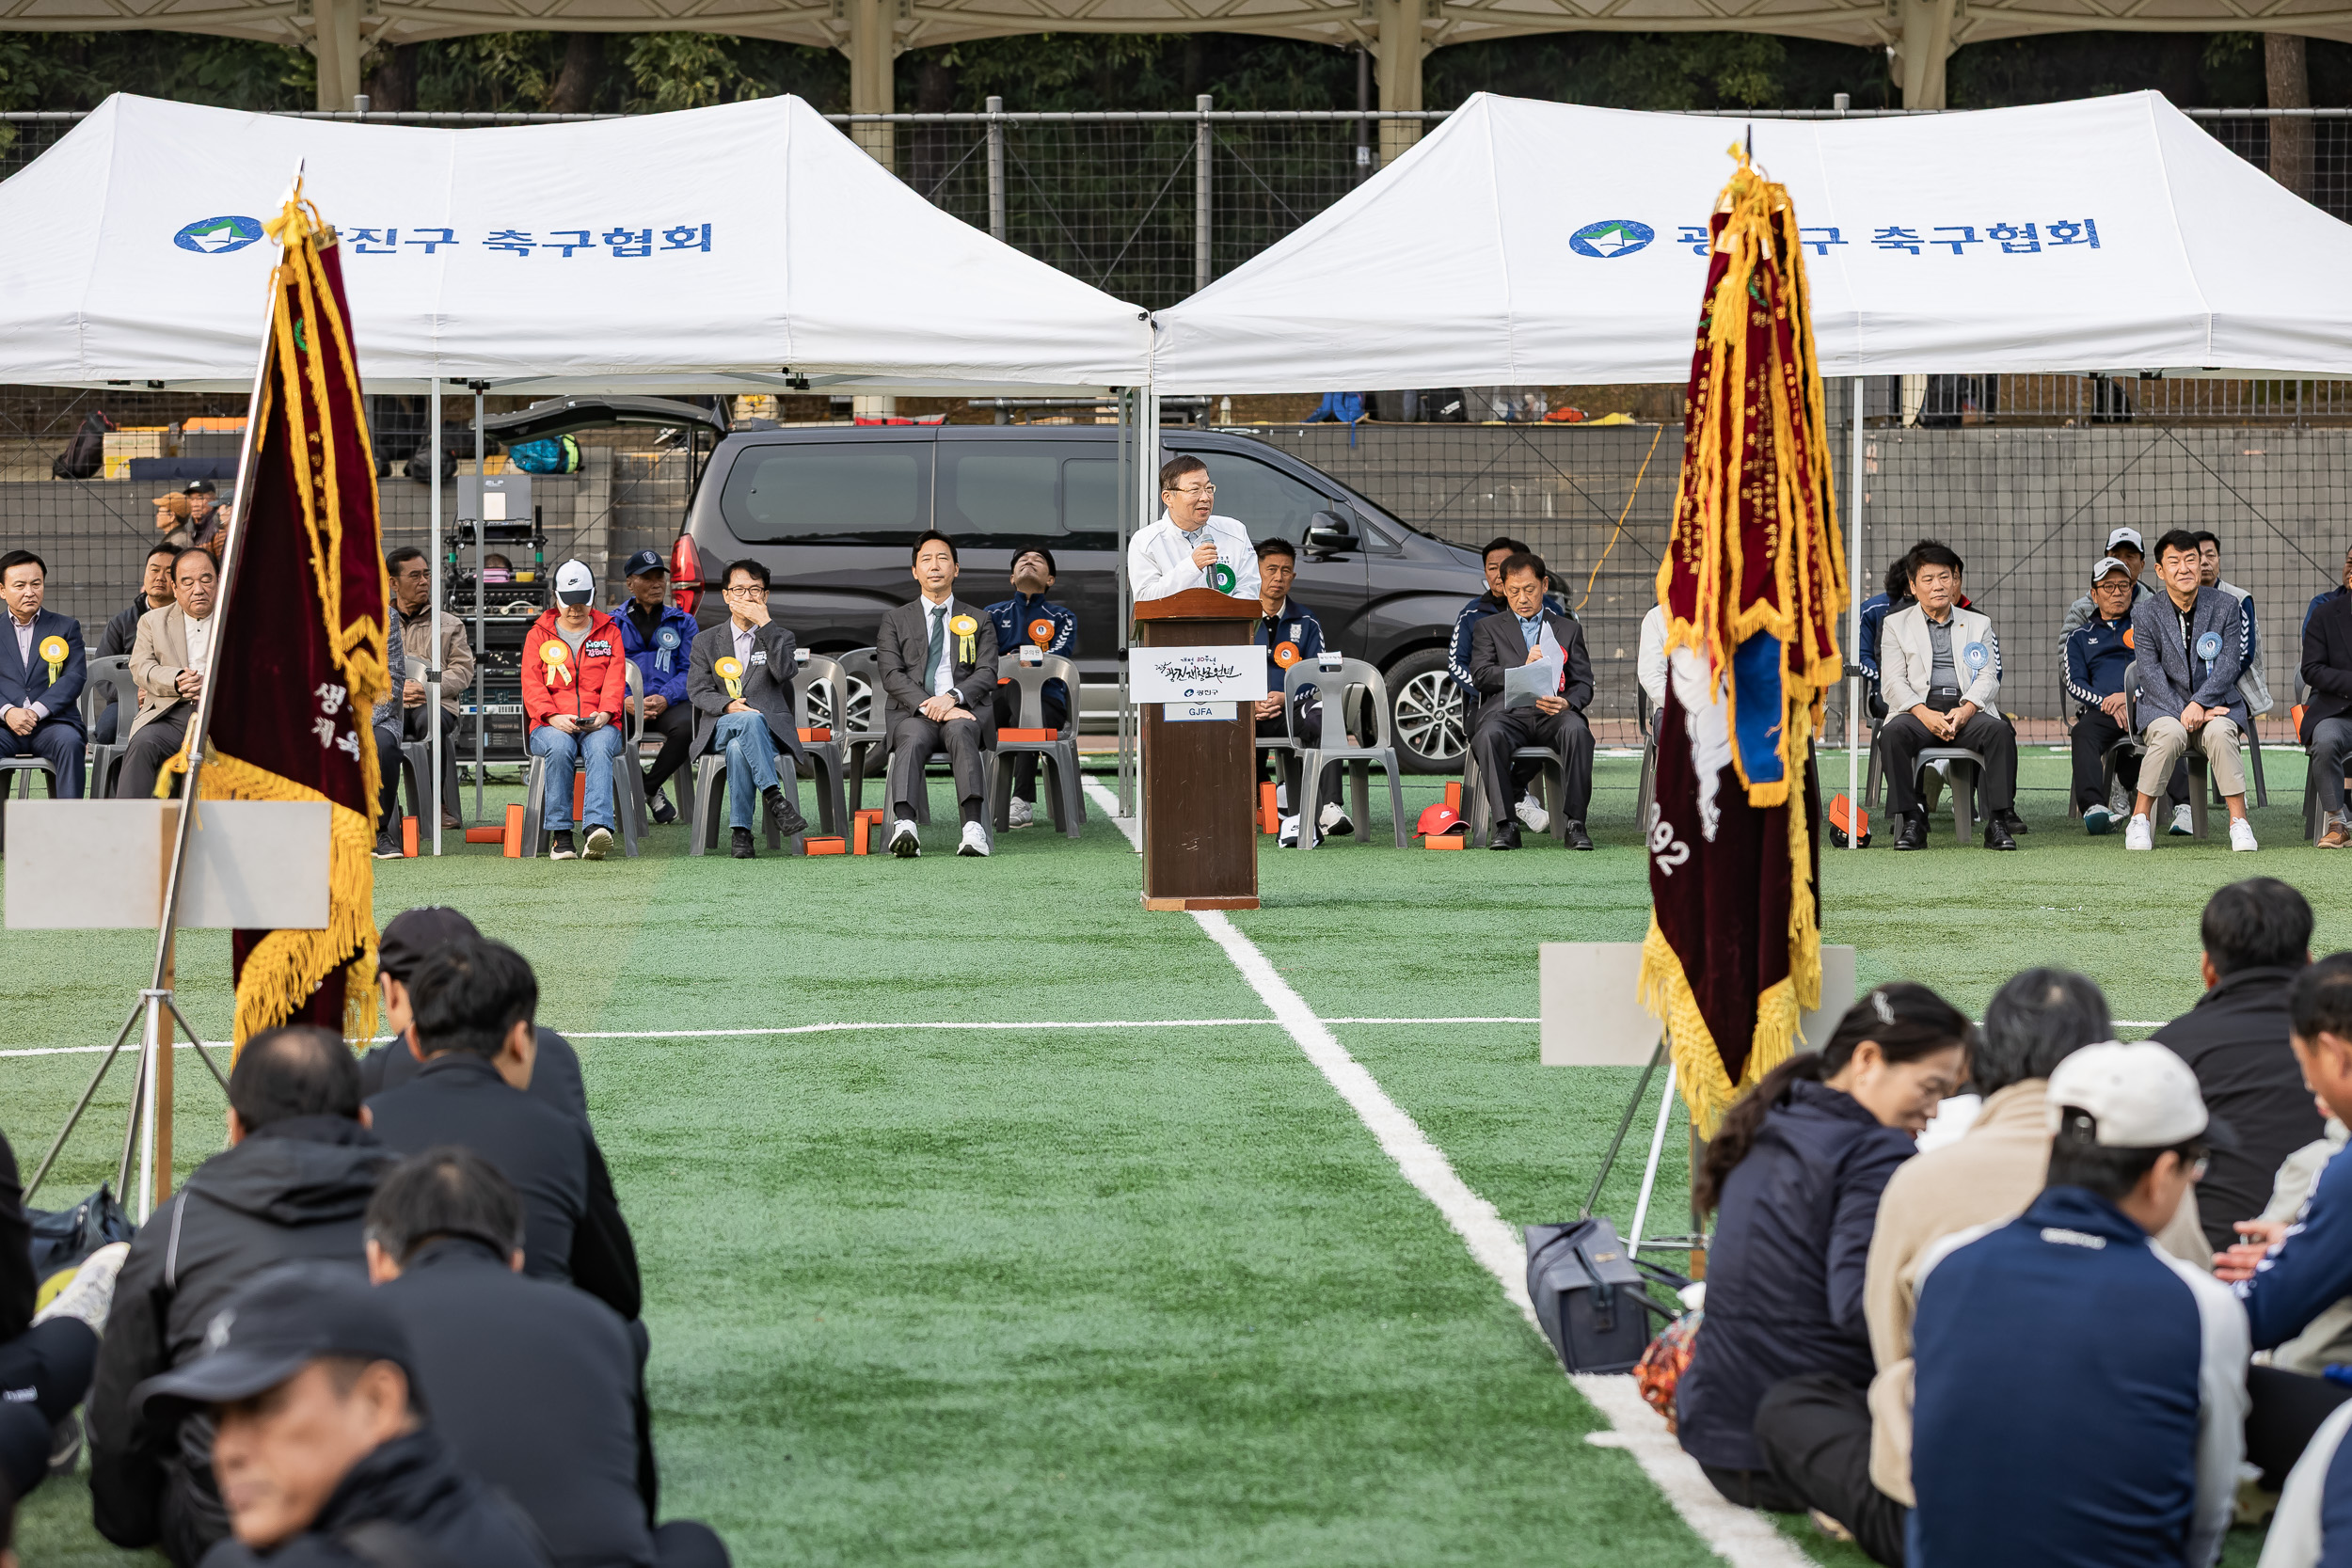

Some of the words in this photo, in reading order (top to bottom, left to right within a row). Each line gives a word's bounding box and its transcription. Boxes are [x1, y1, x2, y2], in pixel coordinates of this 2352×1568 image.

[334, 225, 459, 254] 진구
[483, 224, 711, 258] 축구협회
[1870, 218, 2101, 255] 축구협회
[1196, 689, 1218, 697] 광진구
[1188, 707, 1214, 716] GJFA
